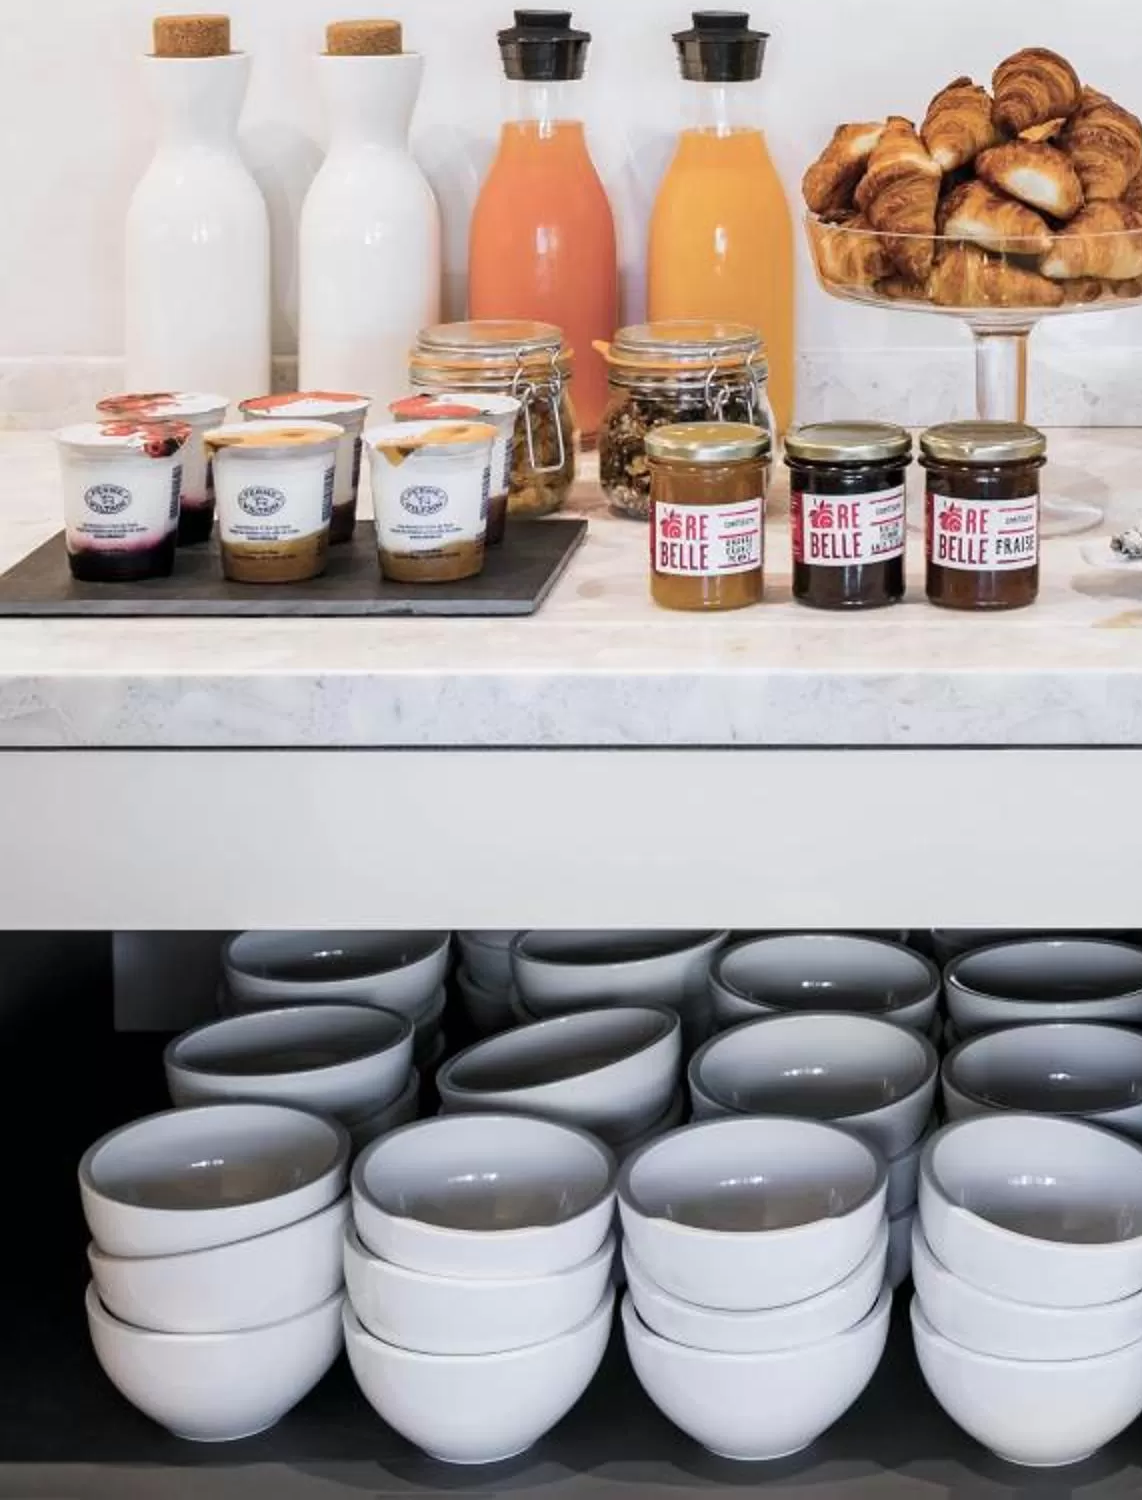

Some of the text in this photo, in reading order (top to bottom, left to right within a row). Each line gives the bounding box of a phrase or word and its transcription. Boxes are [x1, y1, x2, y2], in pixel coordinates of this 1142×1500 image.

[660, 541, 709, 571] BELLE
[810, 531, 863, 559] BELLE
[938, 534, 989, 565] BELLE
[995, 533, 1035, 555] FRAISE
